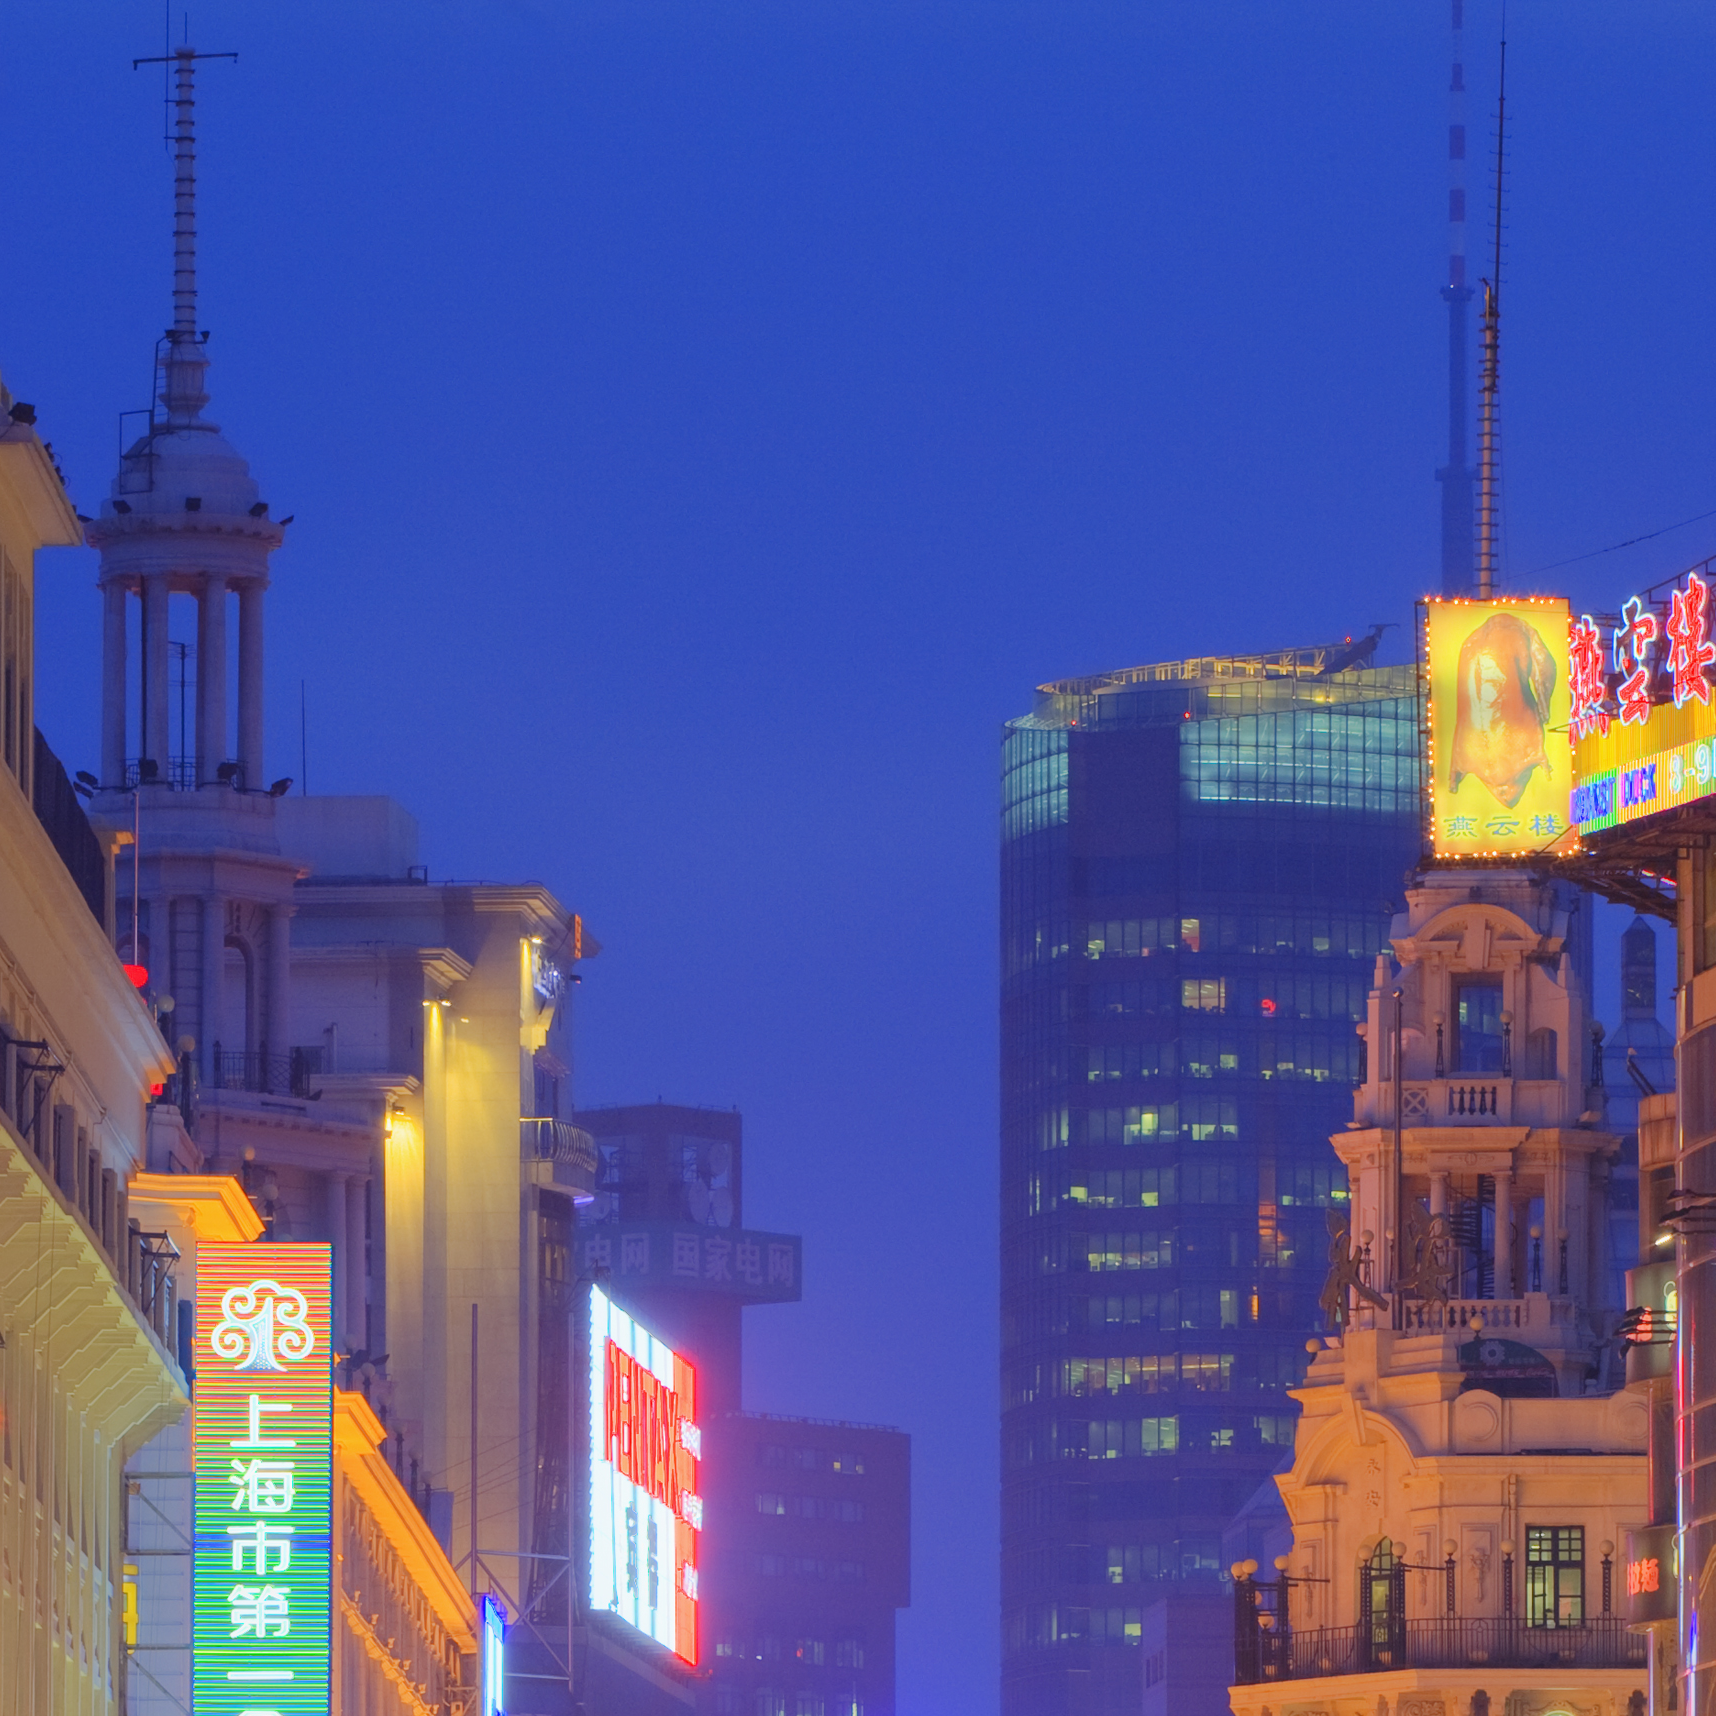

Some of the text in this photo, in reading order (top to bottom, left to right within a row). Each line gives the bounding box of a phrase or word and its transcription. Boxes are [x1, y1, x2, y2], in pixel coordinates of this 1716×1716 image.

[1444, 814, 1564, 840] 燕云楼
[673, 1232, 794, 1288] 国家电网
